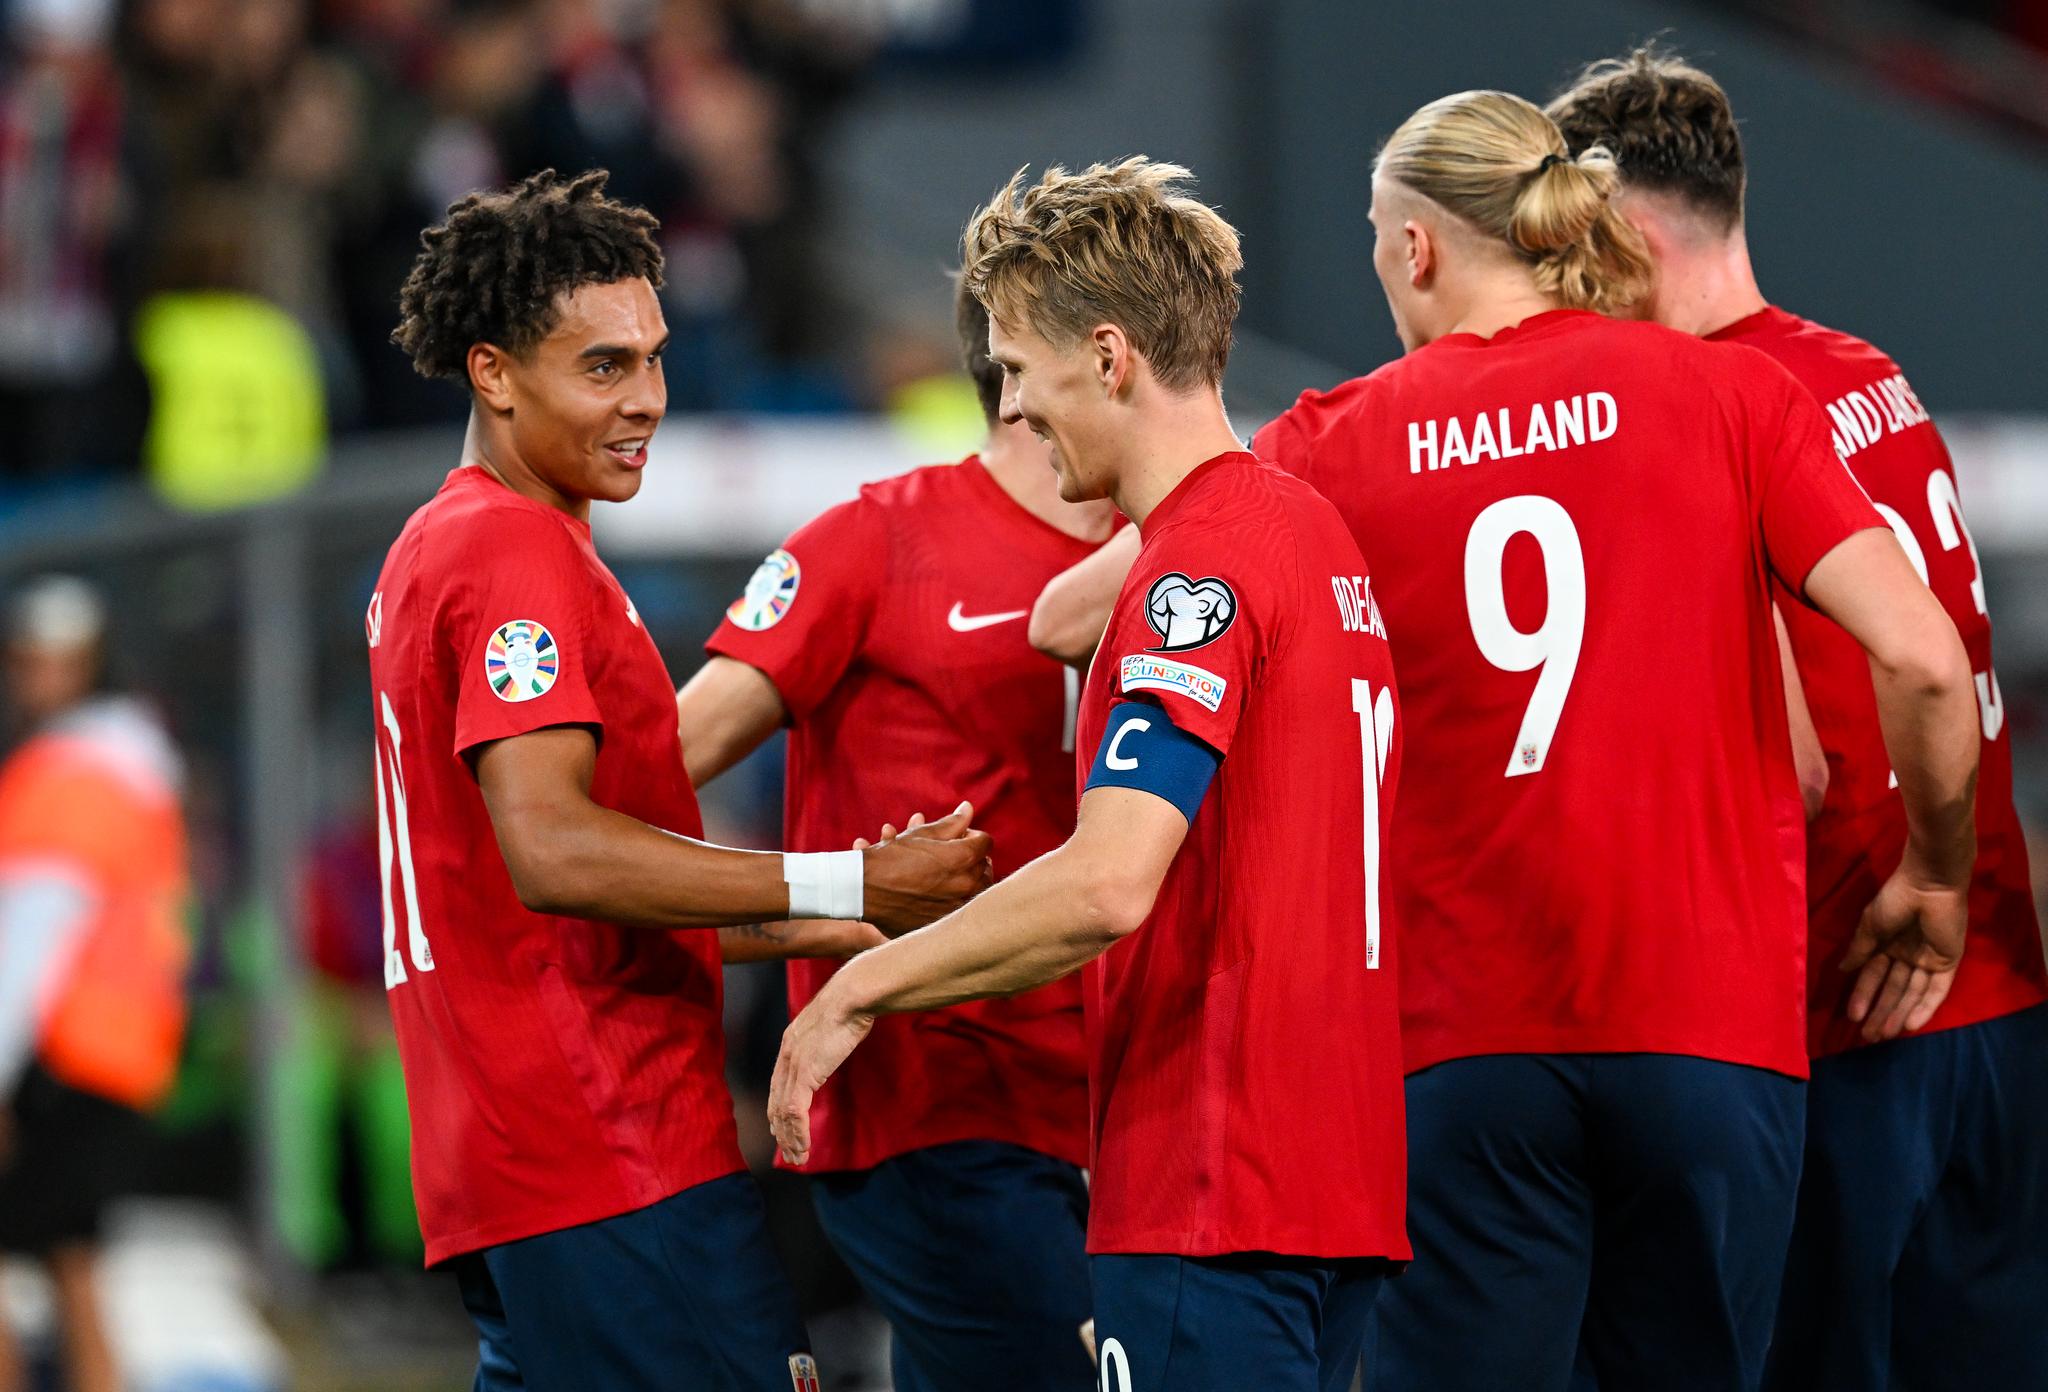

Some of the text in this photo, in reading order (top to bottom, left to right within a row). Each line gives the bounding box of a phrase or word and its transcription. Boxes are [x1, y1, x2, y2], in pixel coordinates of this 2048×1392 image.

[1408, 391, 1618, 474] HAALAND
[1123, 656, 1144, 667] UEFA
[1464, 494, 1586, 777] 9
[1105, 717, 1150, 771] C
